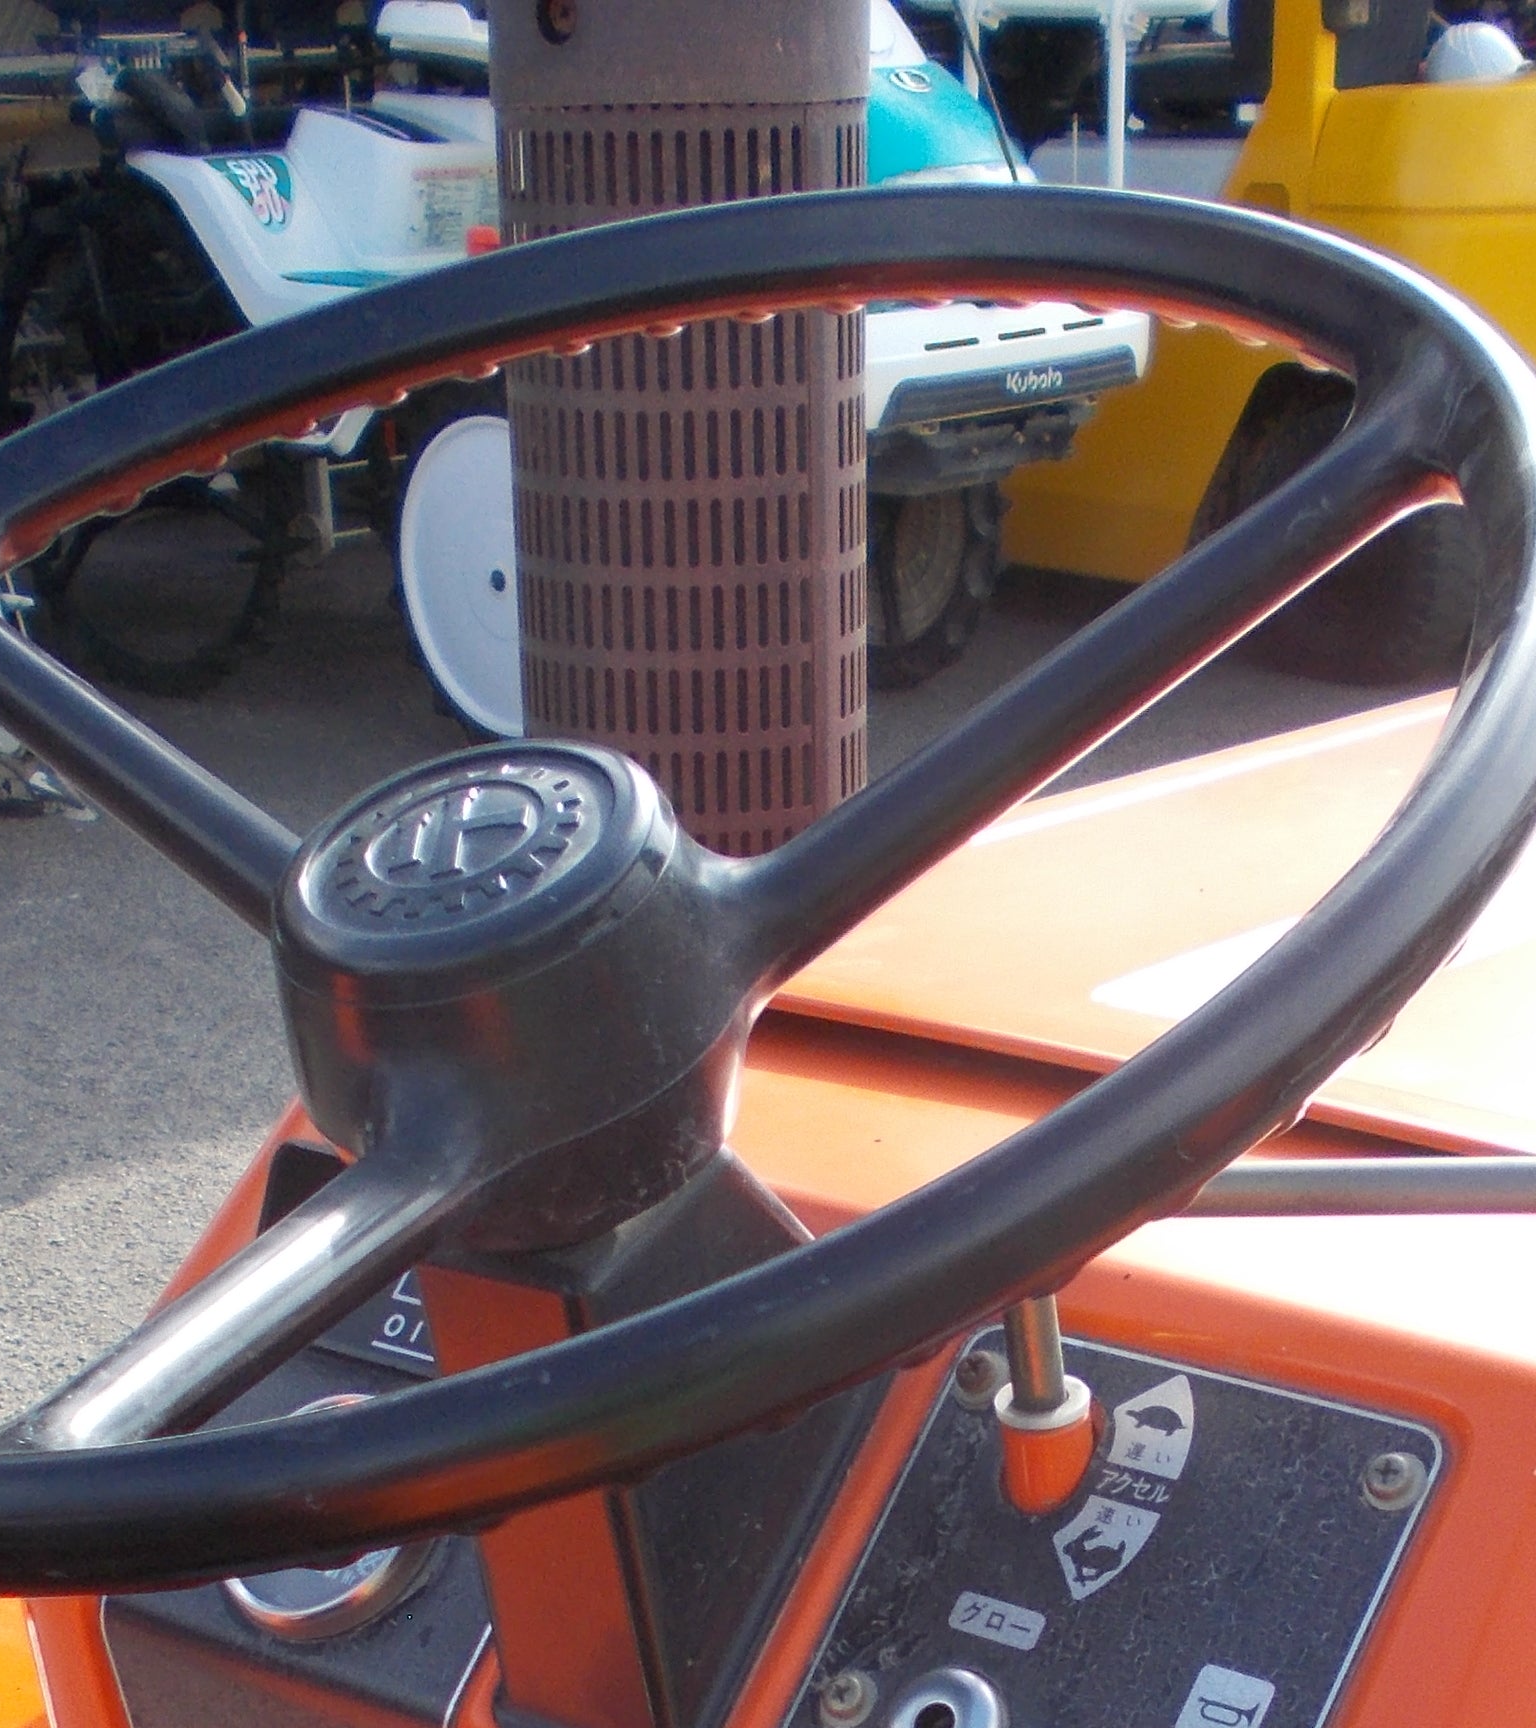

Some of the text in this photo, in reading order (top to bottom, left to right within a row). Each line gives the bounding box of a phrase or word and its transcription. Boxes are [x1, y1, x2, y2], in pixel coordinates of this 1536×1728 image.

[1005, 366, 1063, 394] Kubota
[1095, 1468, 1170, 1504] アクセル
[961, 1601, 1031, 1634] グロー
